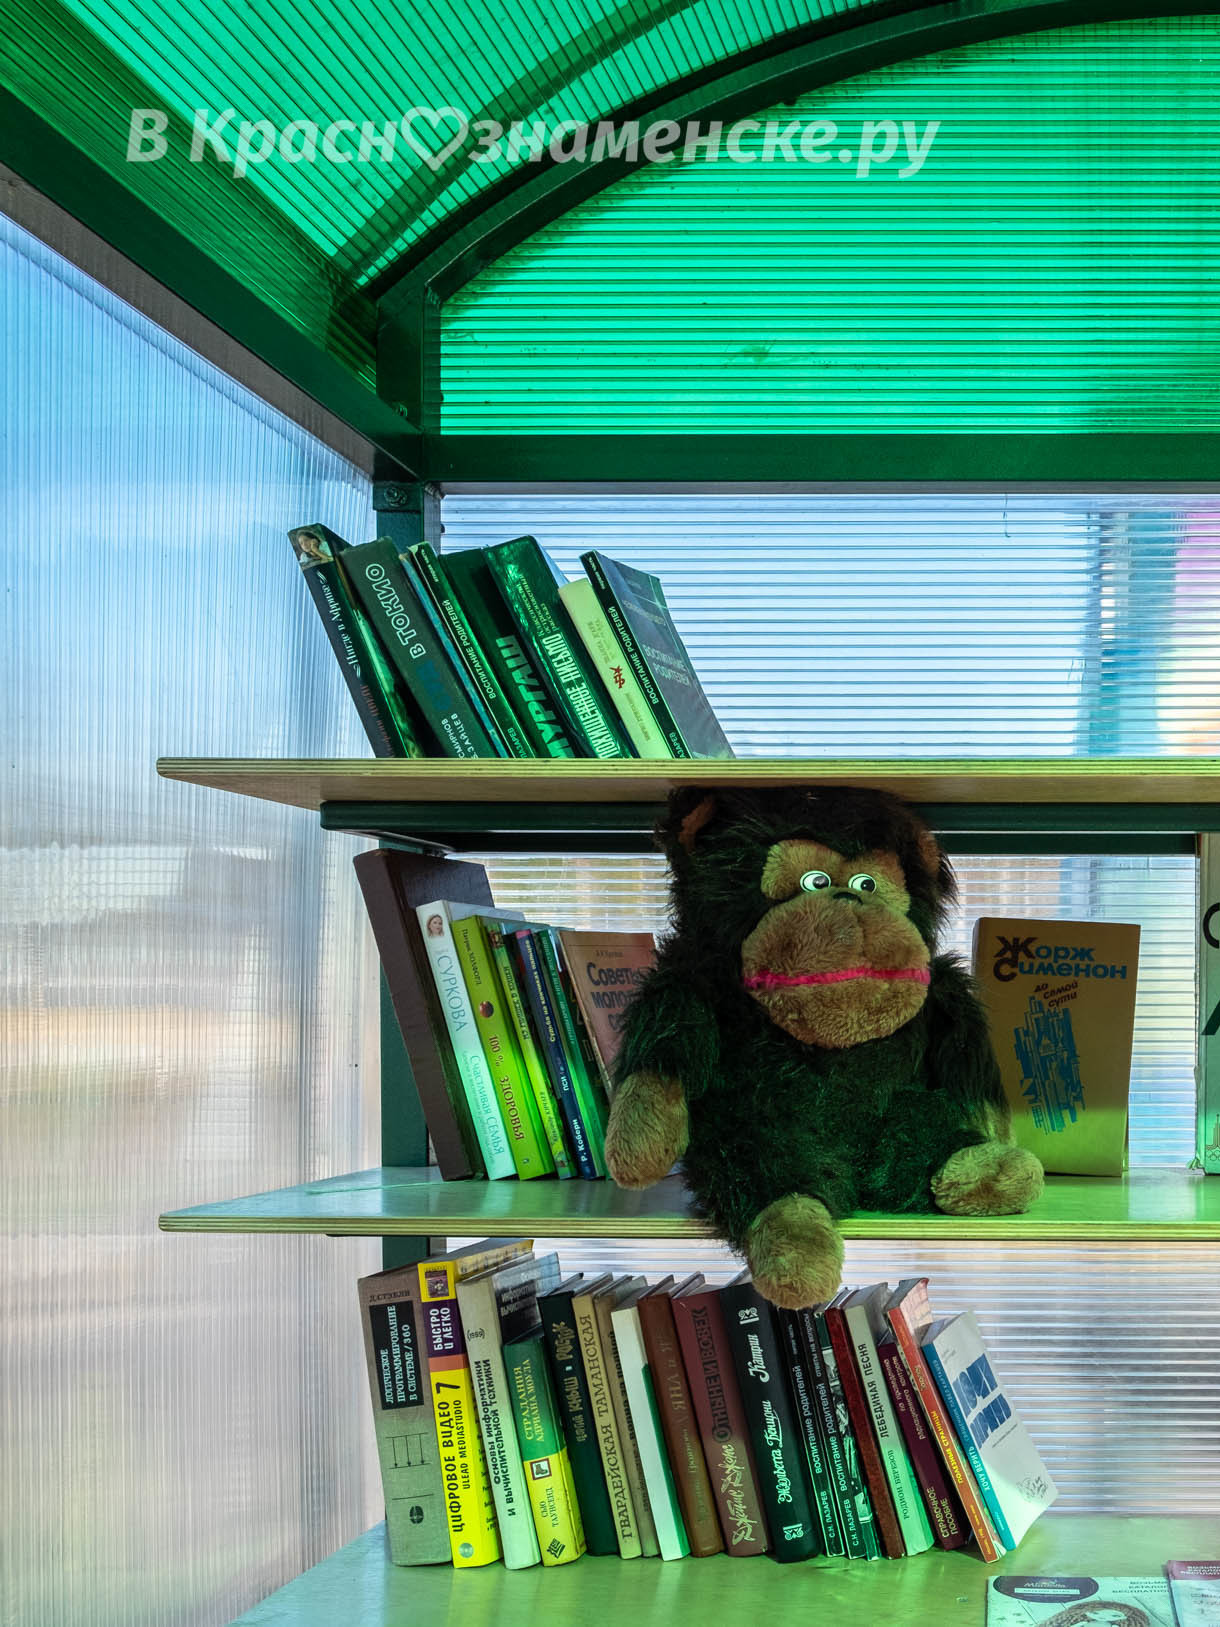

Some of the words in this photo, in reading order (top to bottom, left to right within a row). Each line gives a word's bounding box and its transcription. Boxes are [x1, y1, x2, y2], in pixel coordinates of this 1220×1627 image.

[319, 582, 343, 623] Африке
[365, 563, 419, 642] ТОКИО
[441, 598, 471, 646] РОДИТЕЛЕЙ
[337, 631, 359, 666] Нигде
[607, 605, 635, 652] РОДИТЕЛЕЙ
[465, 646, 497, 699] ВОСПИТАНИЕ
[540, 630, 581, 684] ПИСЬМО
[629, 651, 660, 704] ВОСПИТАНИЕ
[565, 680, 619, 761] ПОХИЩЕННОЕ
[993, 957, 1127, 982] Сименон
[994, 935, 1096, 963] Жорж
[433, 953, 472, 1032] СУРКОВА
[466, 1054, 496, 1115] Счастливая
[483, 1115, 506, 1155] СЕМЬЯ
[486, 1033, 502, 1053] 100
[496, 1075, 525, 1140] ЗДОРОВЬЯ
[429, 1308, 444, 1351] БЫСТРО
[440, 1307, 453, 1338] ЛЕГКО
[380, 1348, 393, 1403] ЛОГИЧЕСКОЕ
[387, 1305, 405, 1401] ПРОГРАММИРОВАНИЕ
[520, 1358, 536, 1393] МОУЛА
[579, 1314, 609, 1417] ТАМАНСКАЯ
[740, 1331, 771, 1385] Катрин
[857, 1343, 873, 1376] ПЕСНЯ
[435, 1379, 461, 1393] 7
[471, 1360, 495, 1437] информатики
[480, 1358, 498, 1405] техники
[510, 1365, 537, 1440] СТРАДАНИЯ
[791, 1364, 813, 1416] родителей
[436, 1400, 457, 1448] ВИДЕО
[450, 1398, 469, 1458] MEDIASTUDIO
[526, 1394, 546, 1442] АДРИАНА
[815, 1382, 837, 1434] родителей
[866, 1379, 890, 1439] ЛЕБЕДИНАЯ
[929, 1409, 950, 1447] СТРАНИЦЫ
[488, 1408, 515, 1504] вычислительной
[801, 1416, 825, 1474] воспитание
[828, 1435, 848, 1491] воспитание
[966, 1444, 983, 1472] ВЕРИТЬ
[441, 1454, 465, 1533] ЦИФРОВОЕ
[459, 1461, 472, 1489] ULEAD
[599, 1422, 633, 1540] ГВАРДЕЙСКАЯ
[977, 1471, 991, 1491] ХОЧУ
[538, 1500, 549, 1518] СЬЮ
[545, 1486, 559, 1527] ТАУНСЕНД
[818, 1489, 834, 1523] ЛАЗАРЕВ
[842, 1498, 857, 1531] ЛАЗАРЕВ
[895, 1485, 910, 1519] РОДИОН
[925, 1485, 950, 1538] СПРАВОЧНОЕ
[939, 1496, 959, 1535] ПОСОБИЕ
